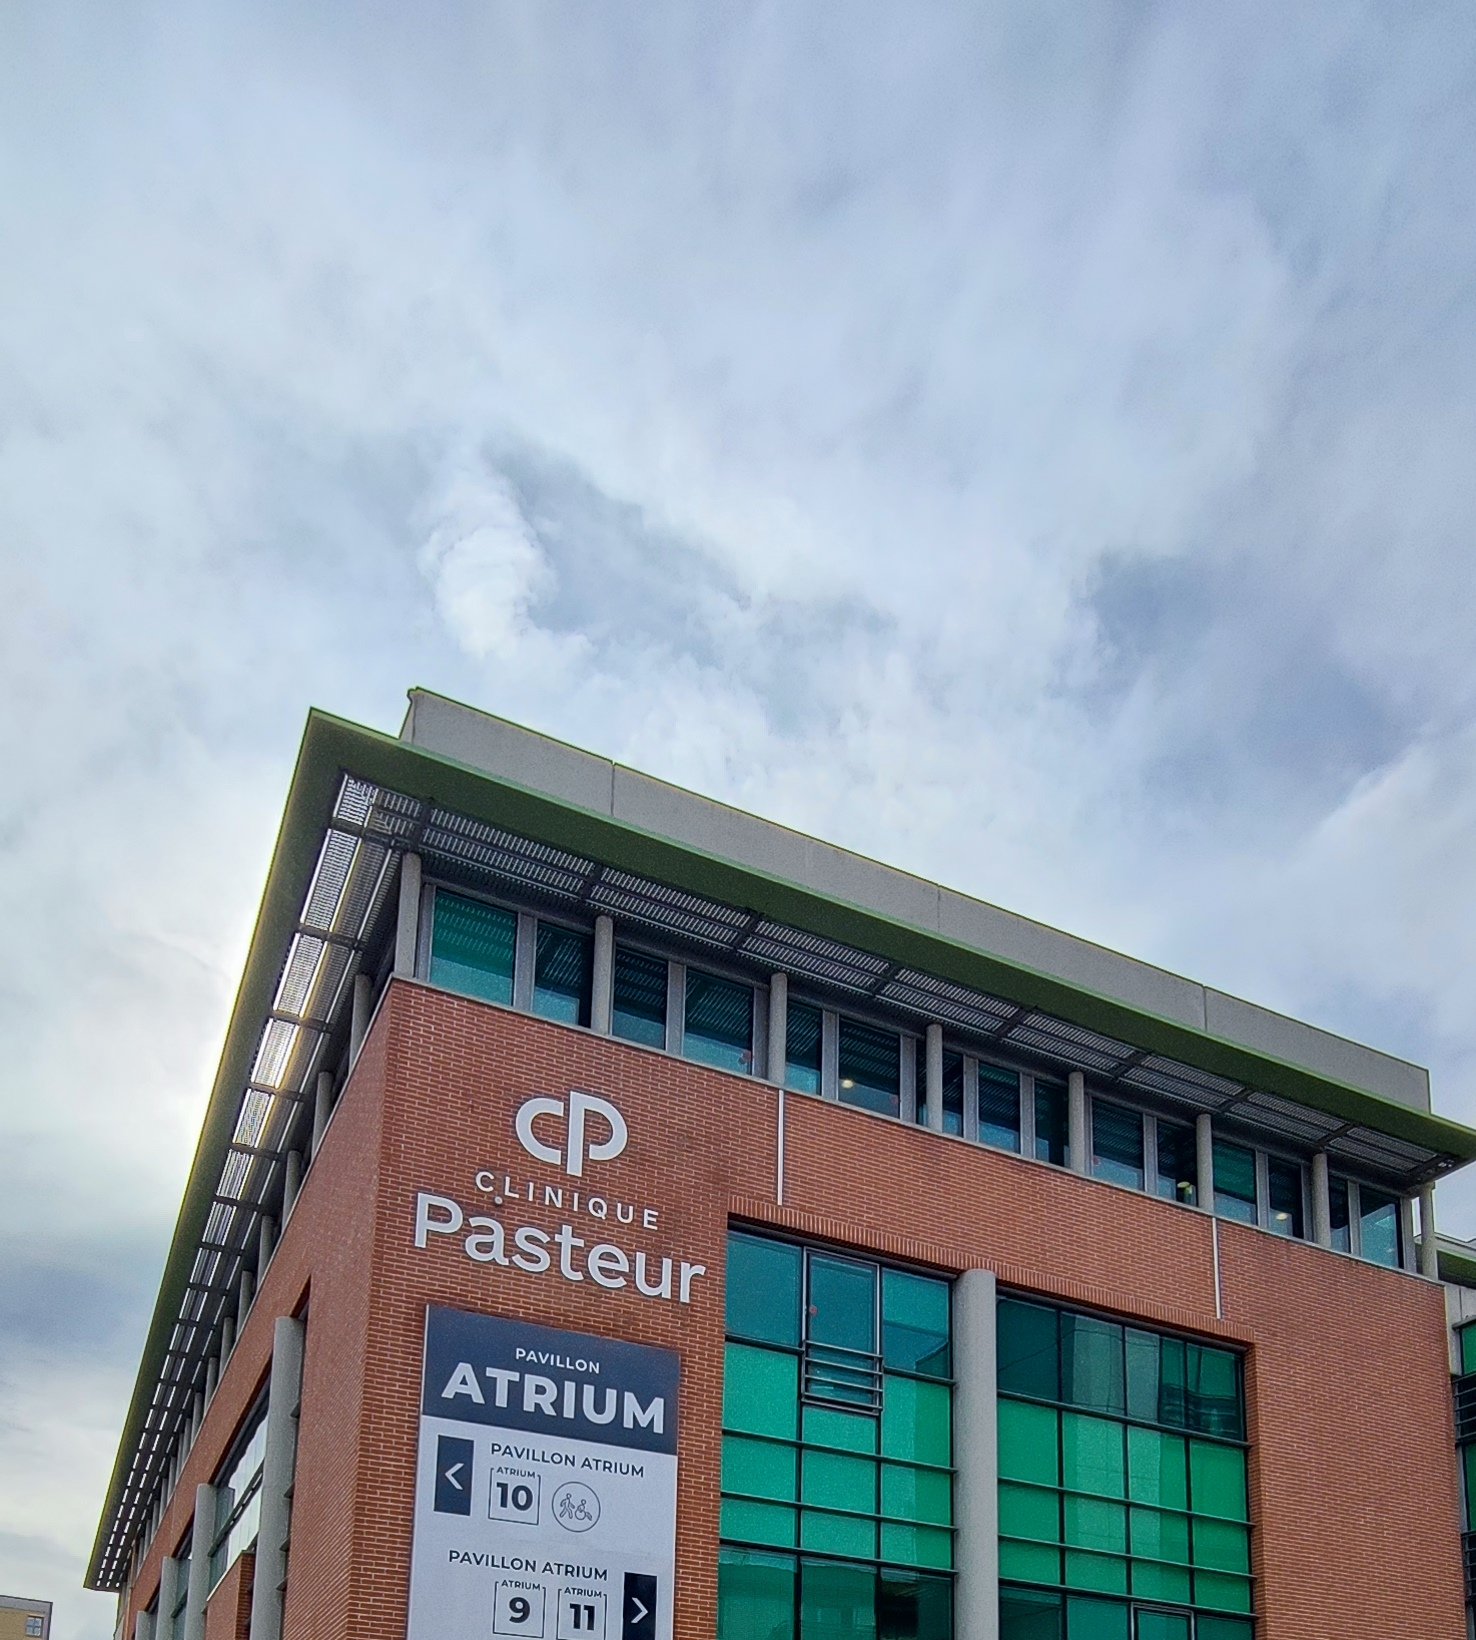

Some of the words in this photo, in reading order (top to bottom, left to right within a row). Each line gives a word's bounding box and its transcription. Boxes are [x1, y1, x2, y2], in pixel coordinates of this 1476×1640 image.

[475, 1171, 659, 1230] CLINIQUE
[414, 1192, 706, 1303] Pasteur
[515, 1347, 600, 1374] PAVILLON
[441, 1362, 664, 1434] ATRIUM
[491, 1443, 576, 1467] PAVILLON
[580, 1457, 645, 1478] ATRIUM
[496, 1466, 536, 1479] ATRIUM
[496, 1482, 533, 1511] 10
[449, 1550, 536, 1573] PAVILLON
[541, 1562, 608, 1581] ATRIUM
[501, 1579, 541, 1591] ATRIUM
[564, 1587, 602, 1598] ATRIUM
[508, 1597, 531, 1624] 9
[569, 1603, 596, 1631] 11
